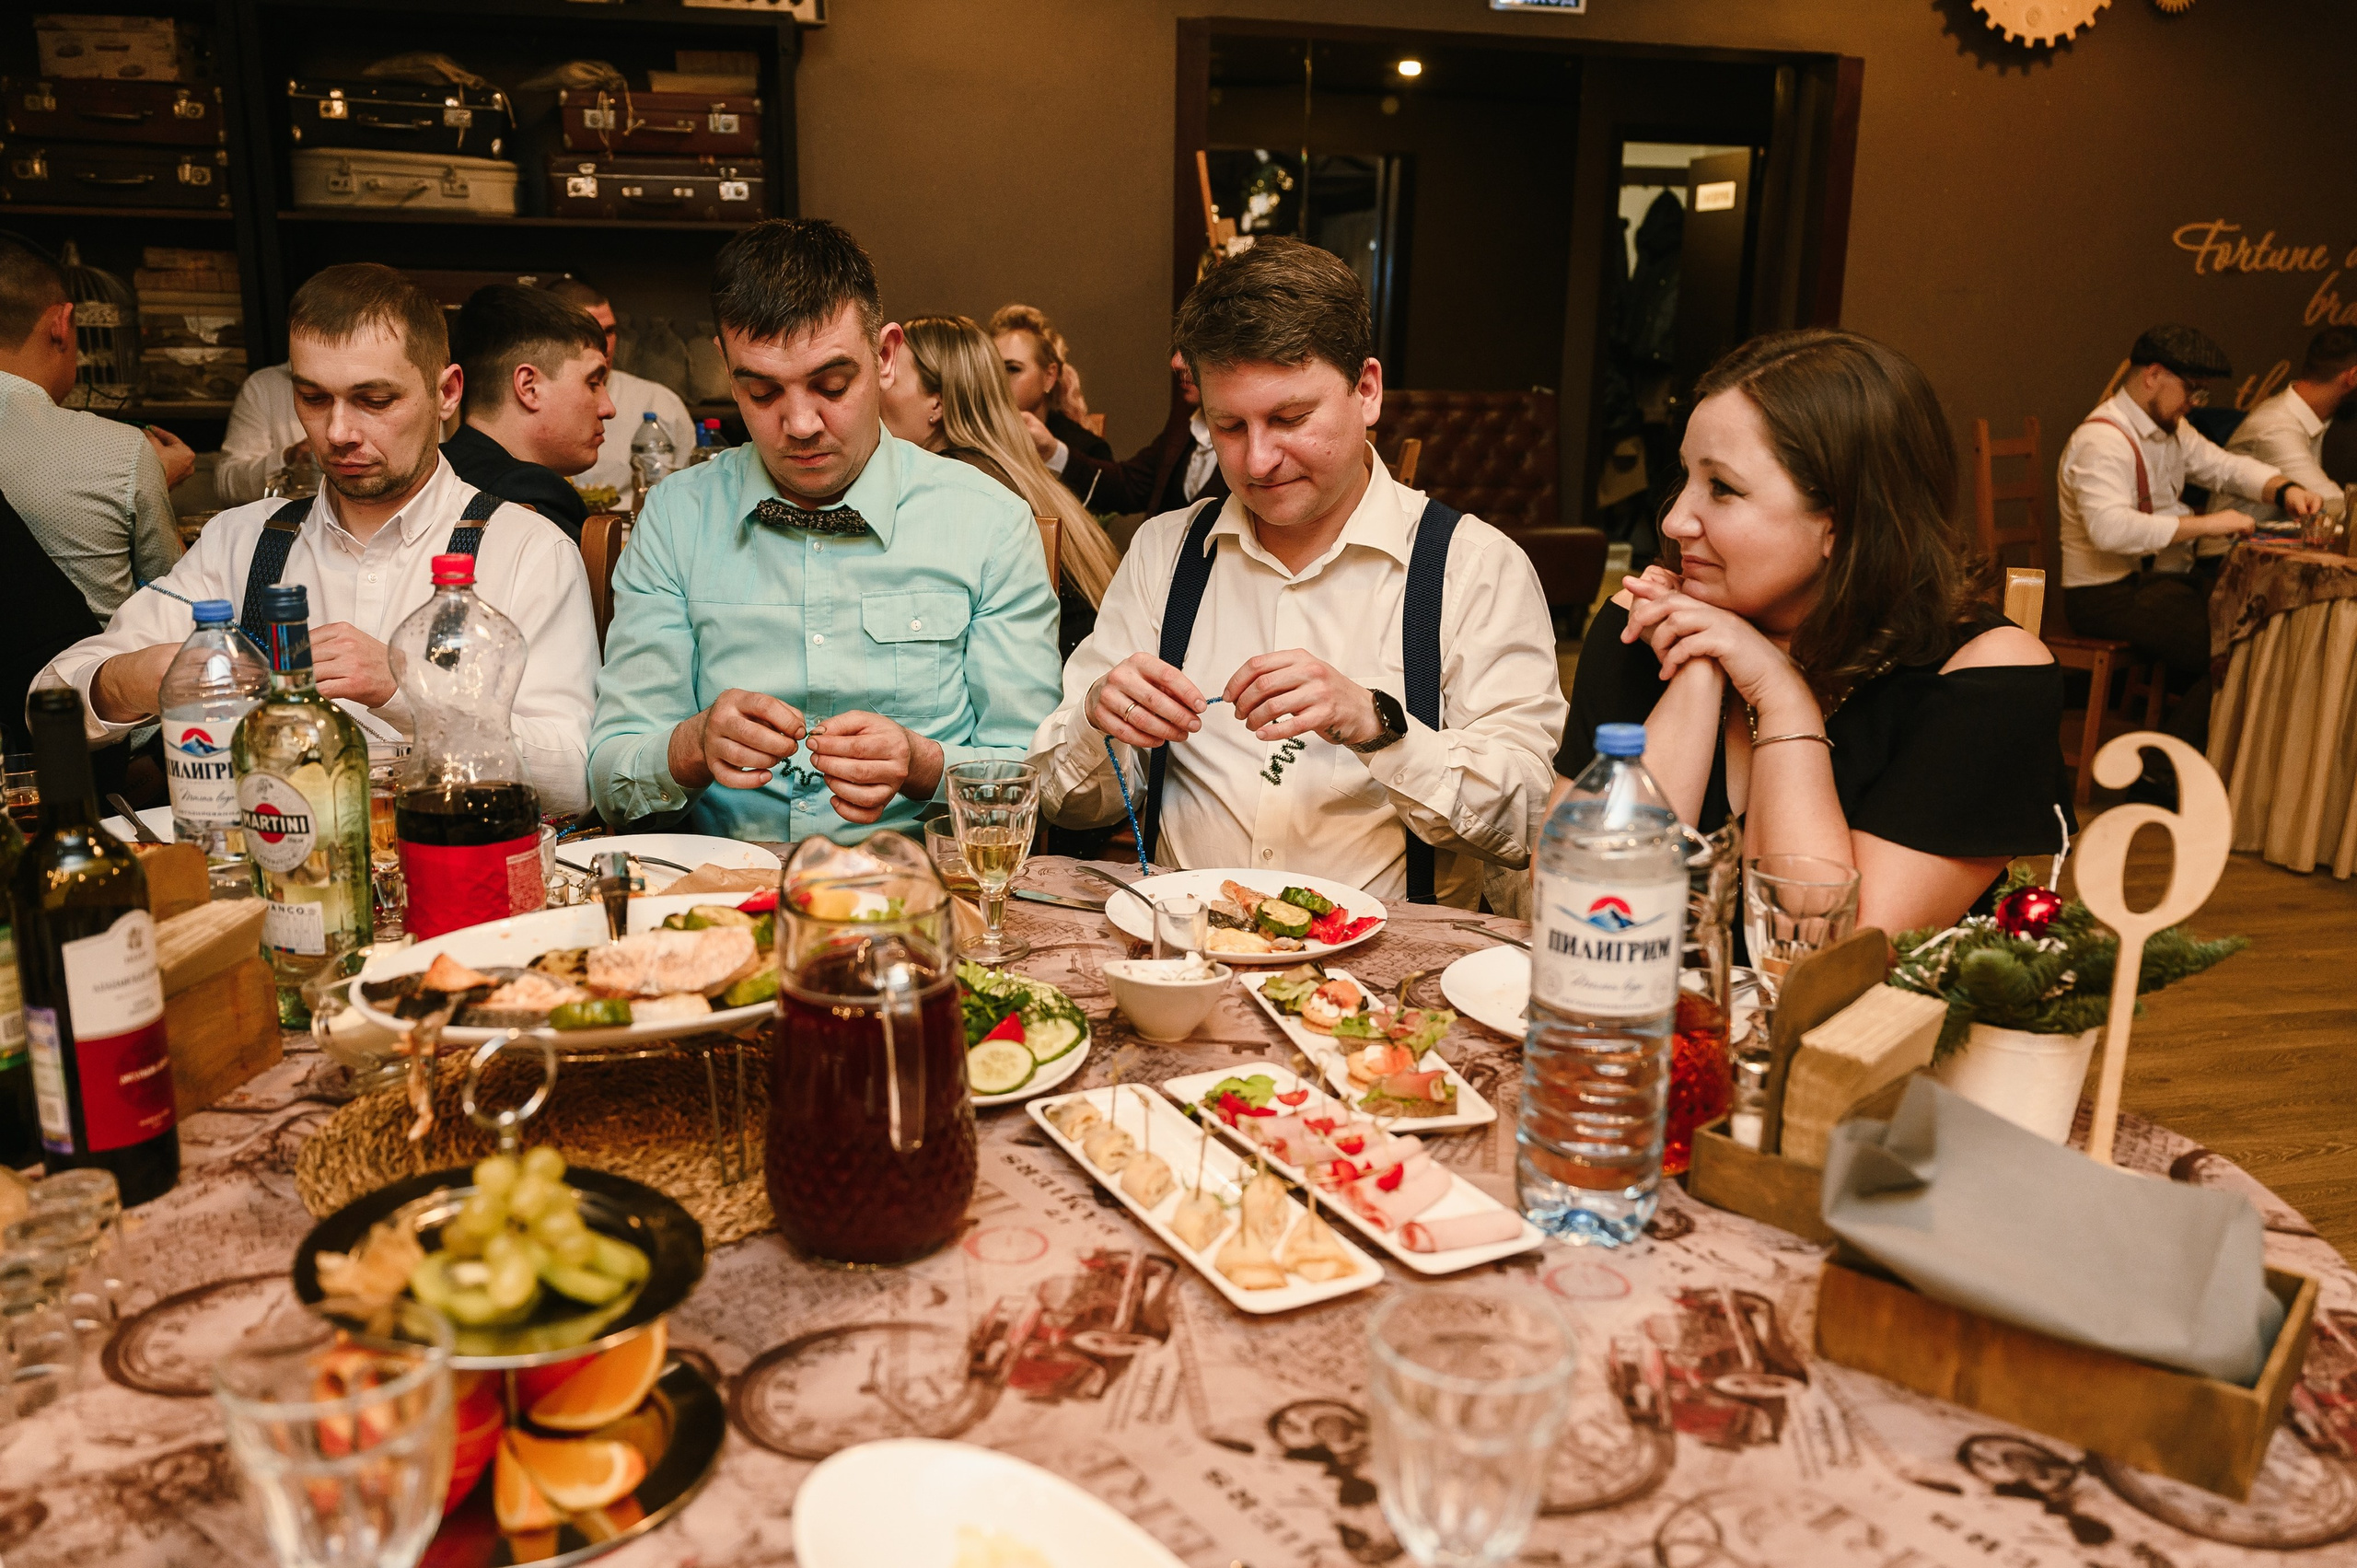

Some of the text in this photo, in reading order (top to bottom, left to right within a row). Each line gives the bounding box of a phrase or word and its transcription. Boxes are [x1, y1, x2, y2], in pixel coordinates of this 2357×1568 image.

[2172, 218, 2330, 274] Fortune
[241, 811, 308, 833] MARTINI
[267, 903, 305, 915] ANCO
[1548, 927, 1671, 963] ПИЛИГРИМ
